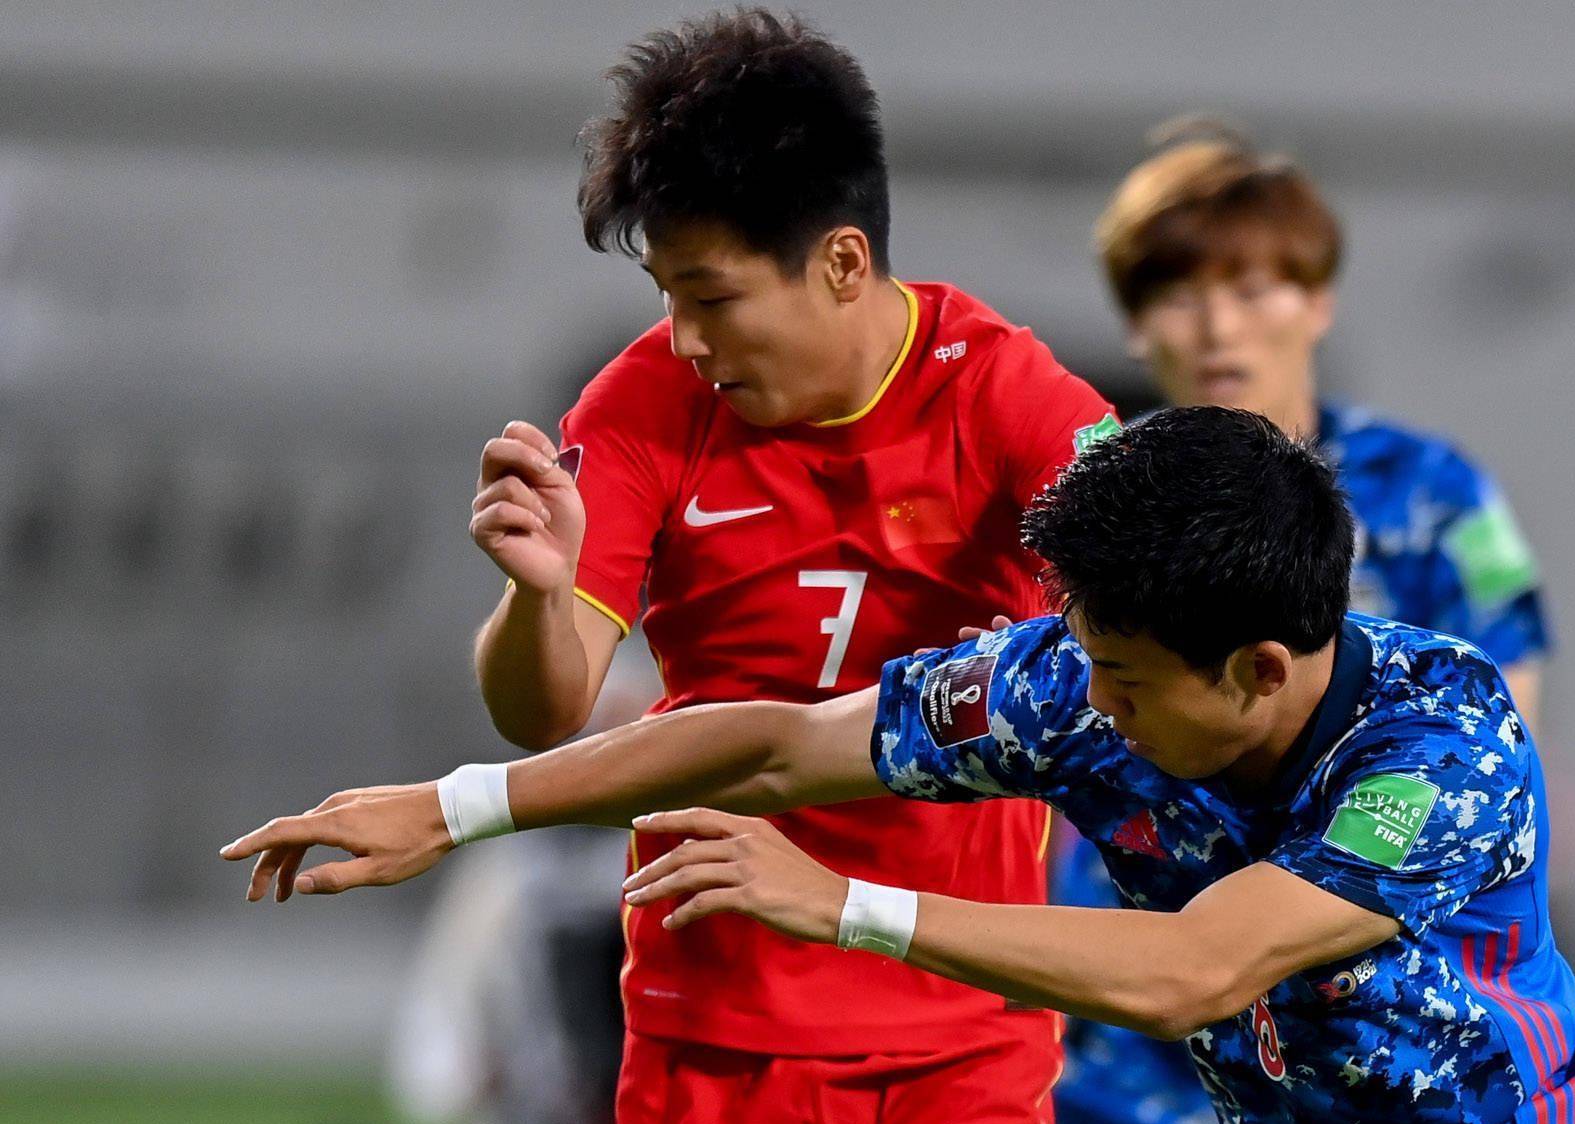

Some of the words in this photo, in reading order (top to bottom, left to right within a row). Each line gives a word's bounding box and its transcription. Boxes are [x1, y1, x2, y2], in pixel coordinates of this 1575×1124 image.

[934, 340, 967, 364] 中国
[798, 570, 867, 689] 7
[1354, 801, 1414, 828] FTBALL
[1355, 791, 1421, 818] LIVING
[1373, 824, 1405, 848] FIFA
